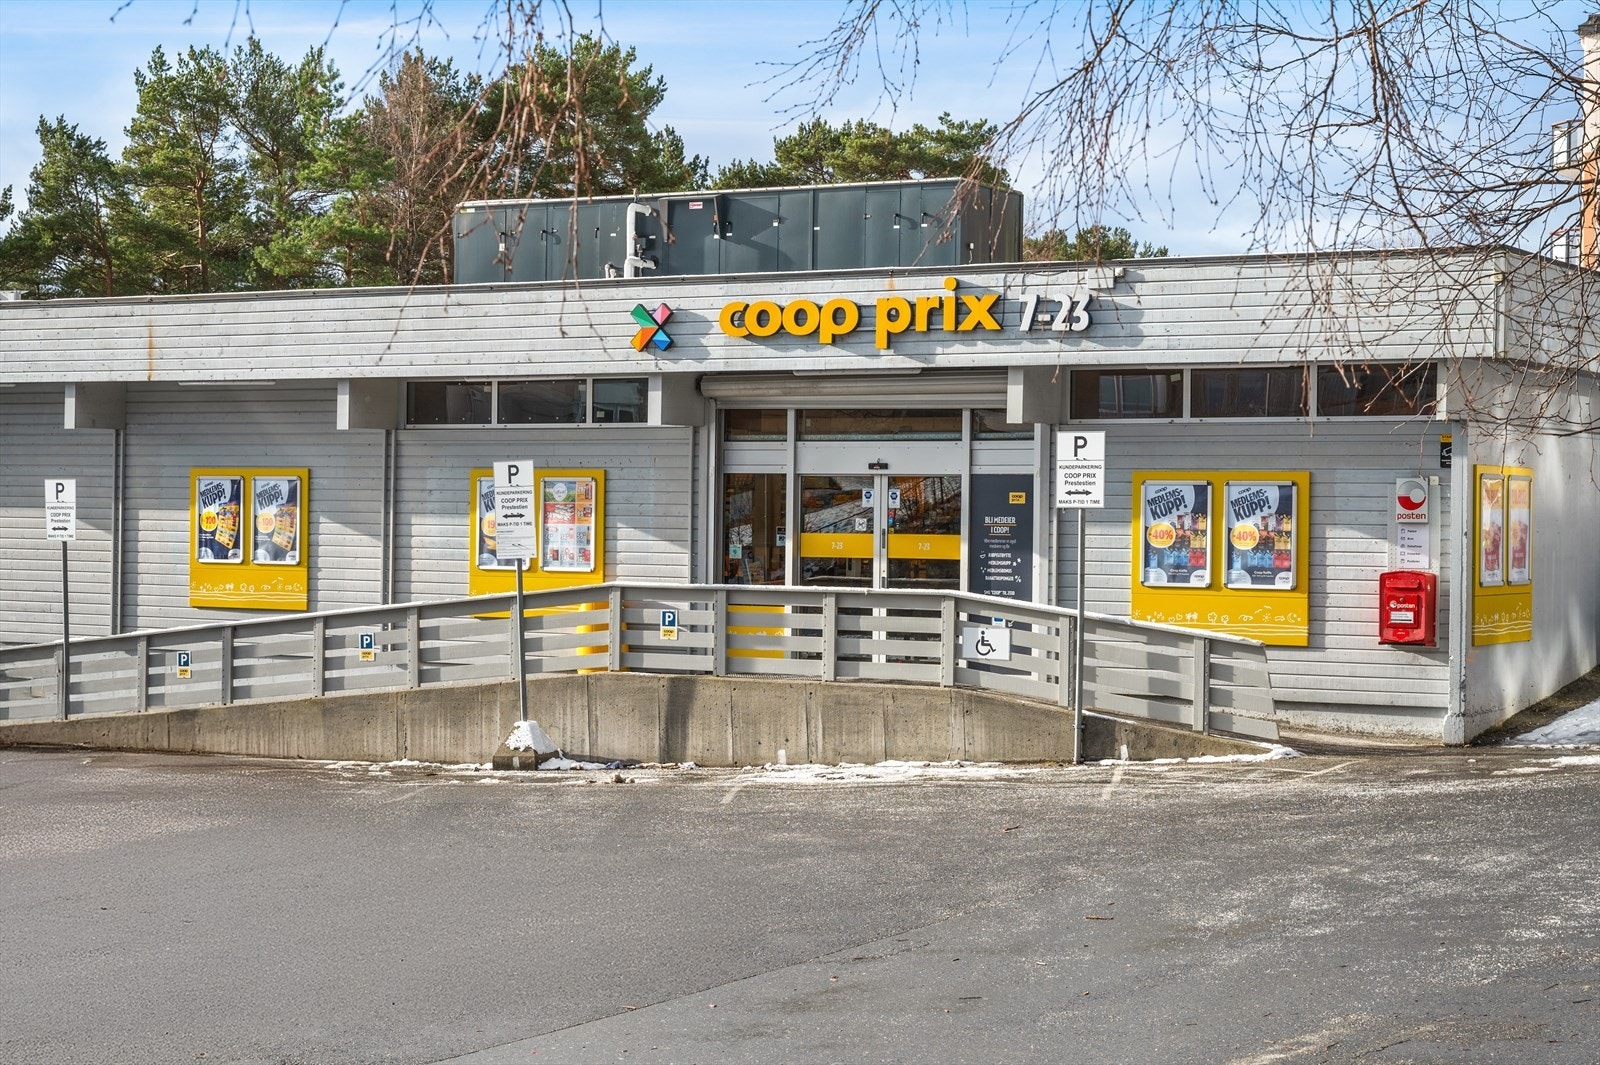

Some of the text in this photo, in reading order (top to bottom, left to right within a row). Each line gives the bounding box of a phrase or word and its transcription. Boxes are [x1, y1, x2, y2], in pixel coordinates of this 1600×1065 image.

[719, 277, 1092, 350] coop prix 7-23
[1074, 435, 1088, 457] P
[507, 464, 520, 484] P
[56, 482, 65, 500] P
[202, 488, 227, 509] KUPP!
[258, 489, 284, 510] KUPP!
[1146, 488, 1182, 508] MEDLEMS-
[1230, 488, 1267, 510] MEDLEMS-
[1150, 495, 1188, 521] KUPP!
[1232, 496, 1272, 522] KUPP!
[1397, 512, 1427, 521] posten
[994, 526, 1010, 534] COOP!
[1150, 529, 1174, 540] -40%
[1232, 530, 1257, 542] -40%
[831, 542, 844, 550] 7-23
[918, 542, 931, 551] 7-23
[665, 612, 674, 626] P
[363, 636, 370, 648] P
[180, 654, 188, 666] P
